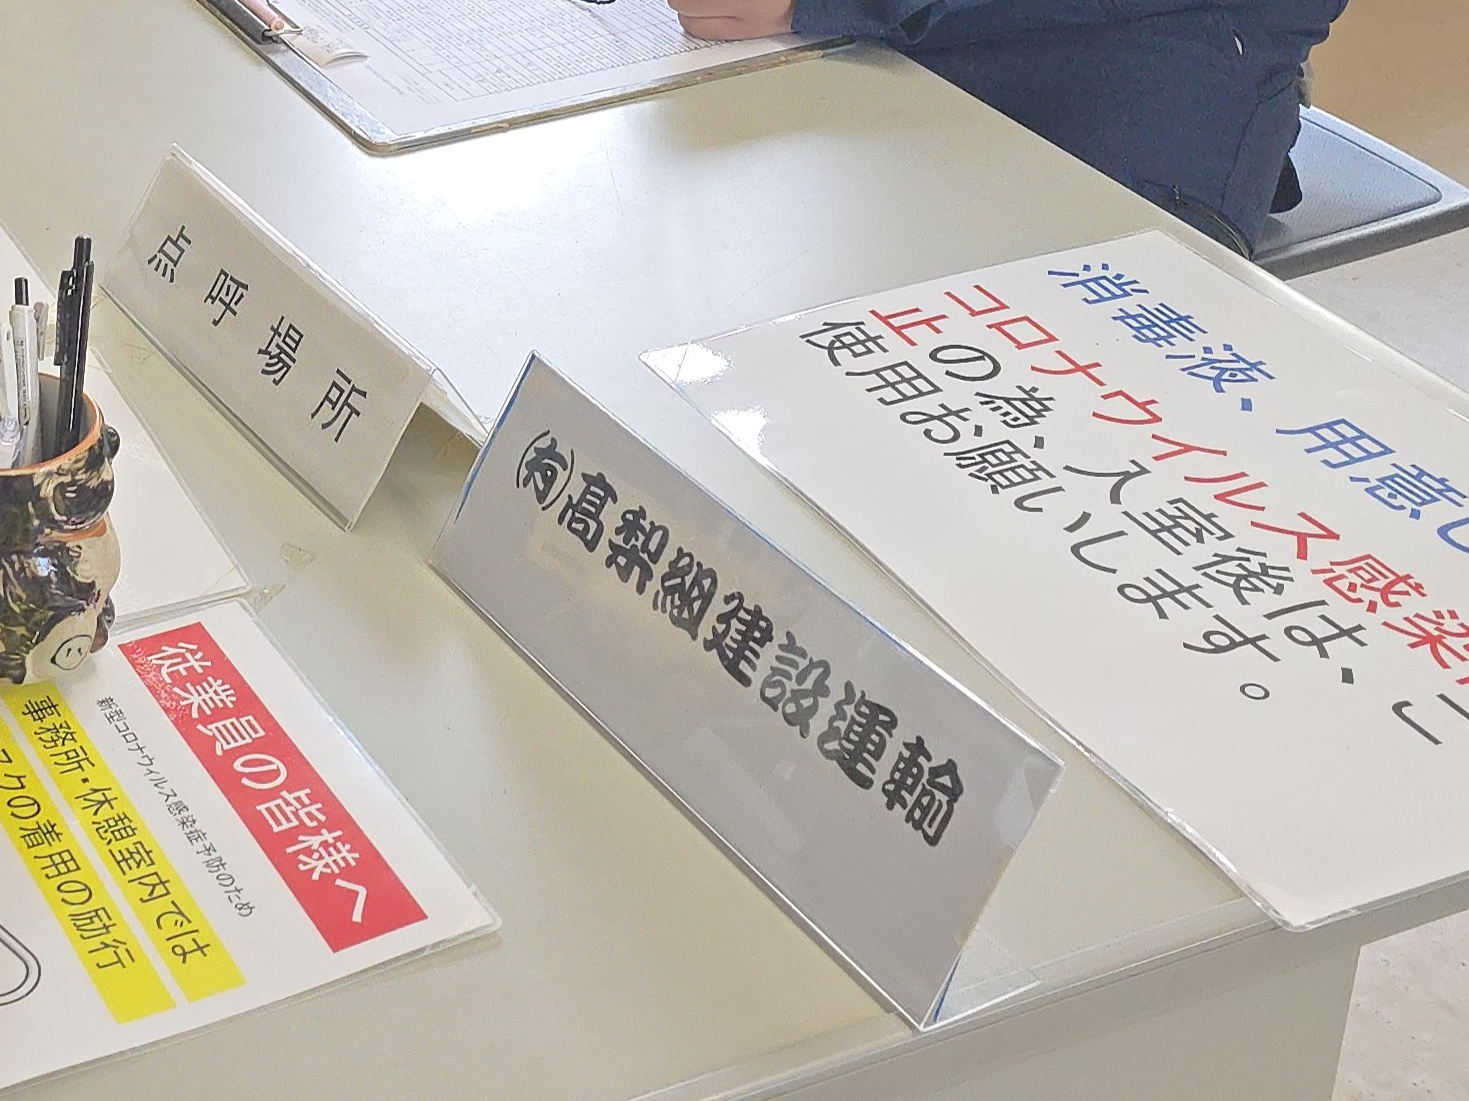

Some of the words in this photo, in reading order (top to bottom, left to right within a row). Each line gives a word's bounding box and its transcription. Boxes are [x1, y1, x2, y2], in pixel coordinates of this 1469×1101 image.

[147, 224, 368, 443] 点呼場所
[799, 321, 1281, 701] 使用お願いします。
[943, 284, 1469, 685] コロナウイルス感染
[19, 694, 212, 965] 事務所・休憩室内では
[145, 641, 368, 924] 従業員の皆様へ
